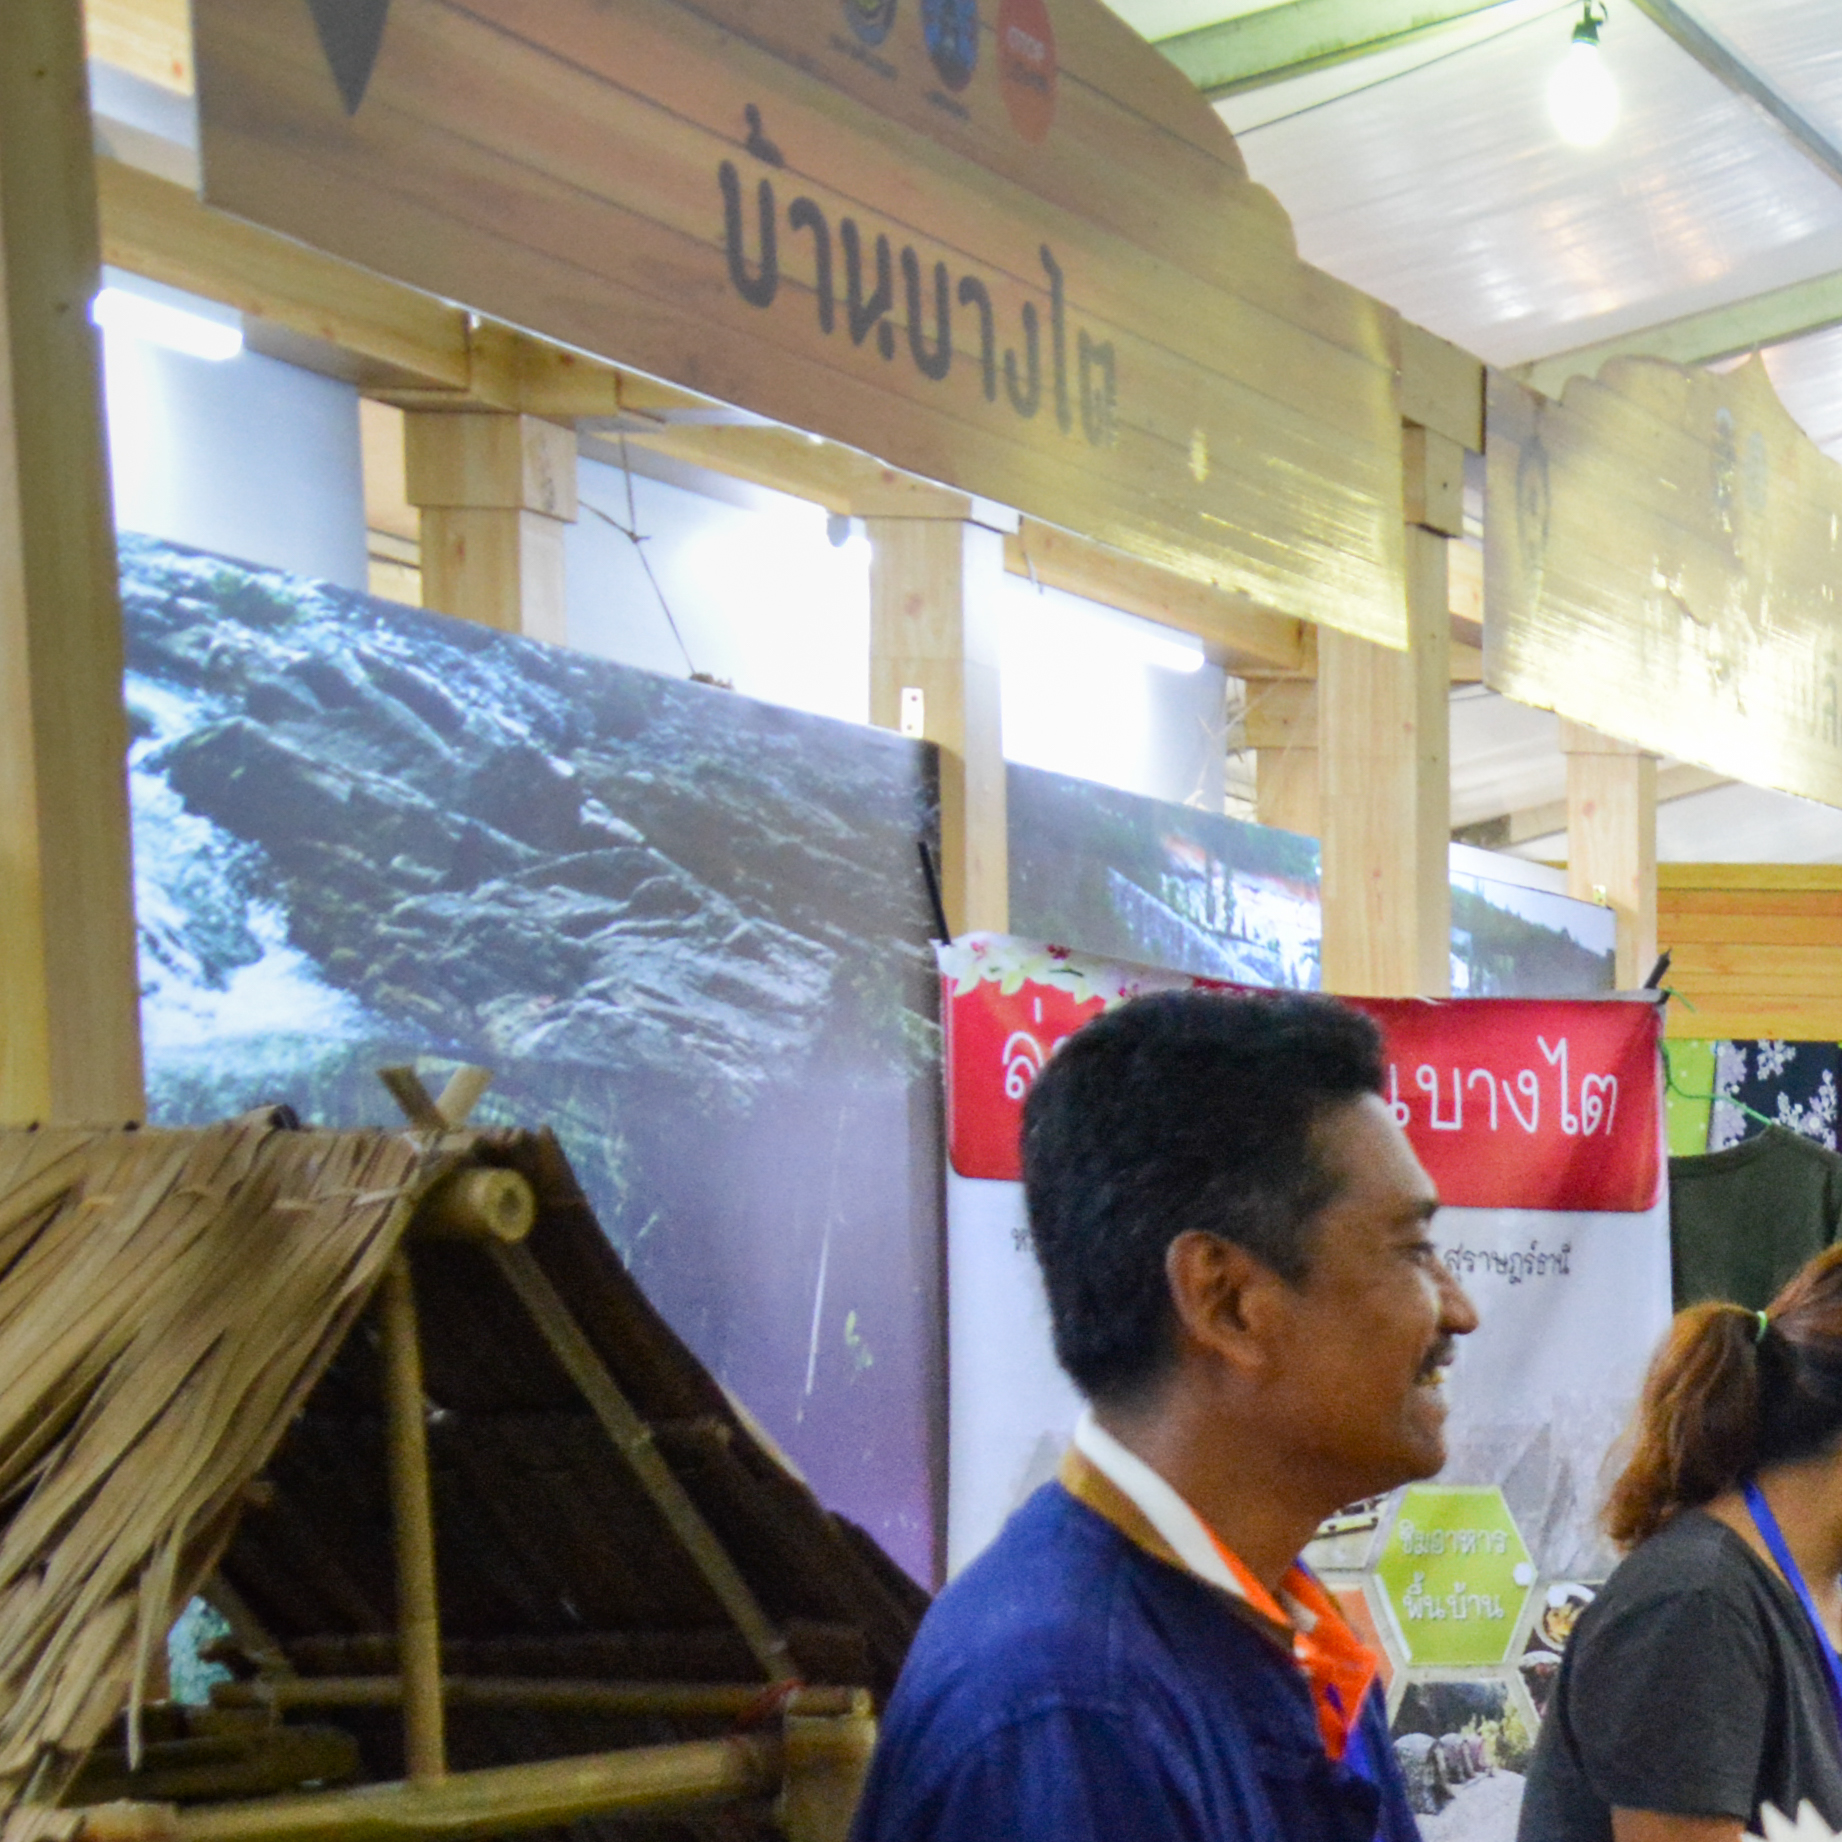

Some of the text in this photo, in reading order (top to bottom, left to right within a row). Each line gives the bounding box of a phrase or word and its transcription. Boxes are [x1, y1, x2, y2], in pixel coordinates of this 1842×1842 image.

[717, 102, 1119, 449] บ้านบางไต
[1402, 1570, 1506, 1620] พื้นบ้าน
